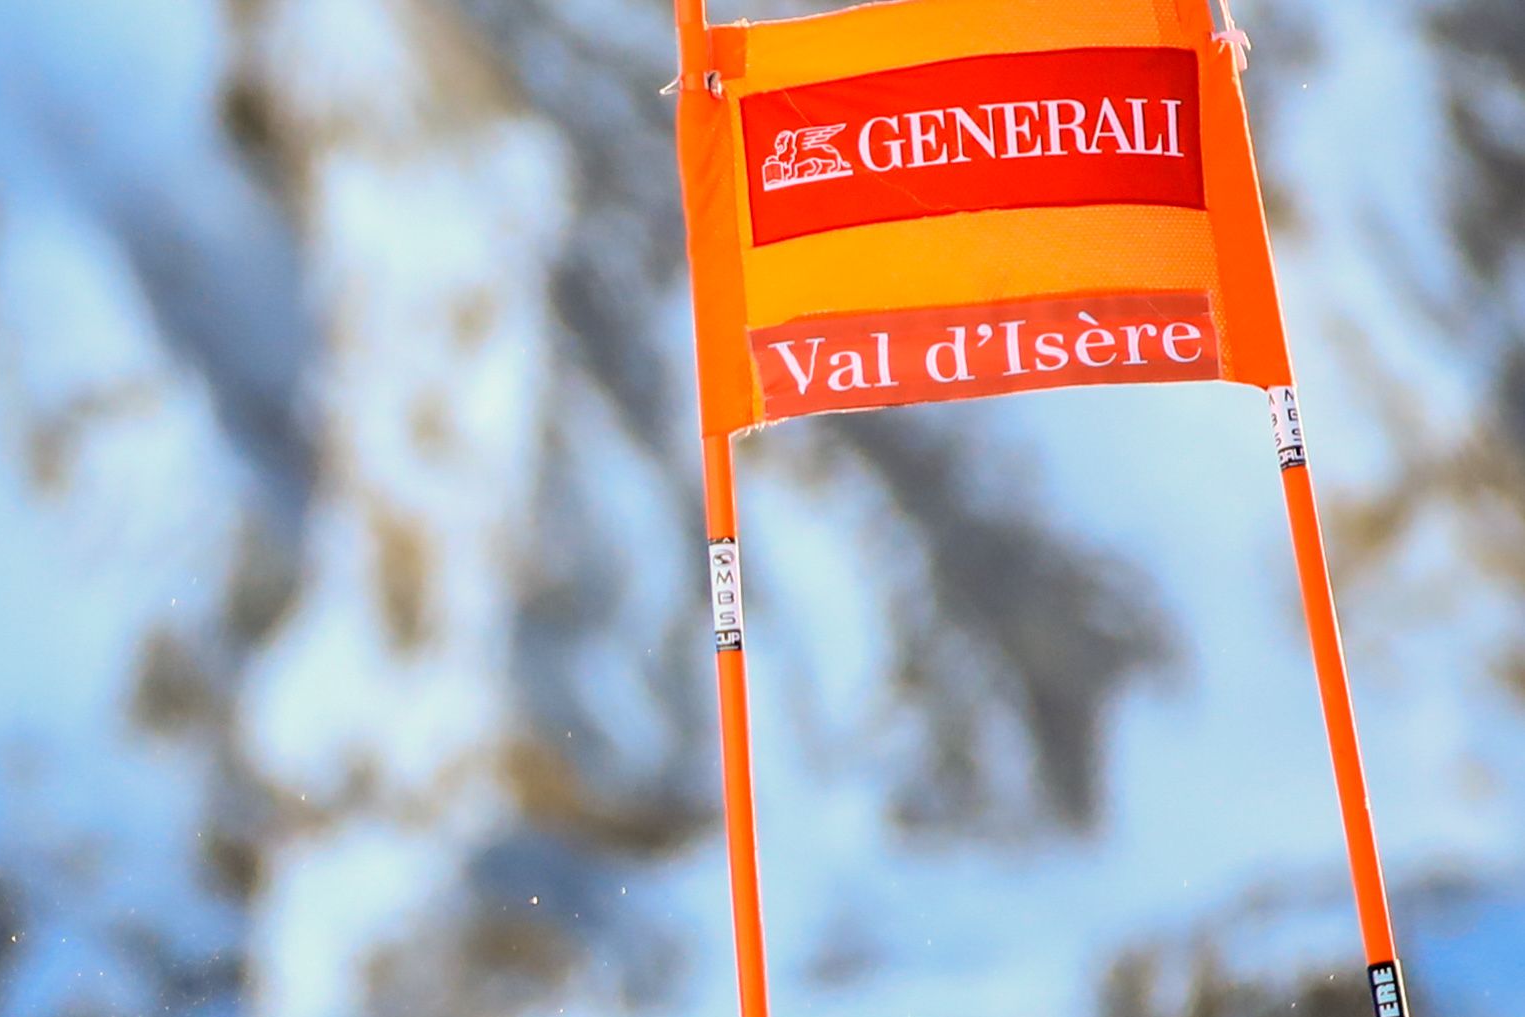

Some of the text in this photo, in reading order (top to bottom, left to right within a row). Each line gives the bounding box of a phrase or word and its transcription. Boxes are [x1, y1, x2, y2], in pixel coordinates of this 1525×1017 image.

[857, 97, 1185, 173] GENERALI
[767, 332, 900, 396] Val
[716, 569, 736, 627] MBS
